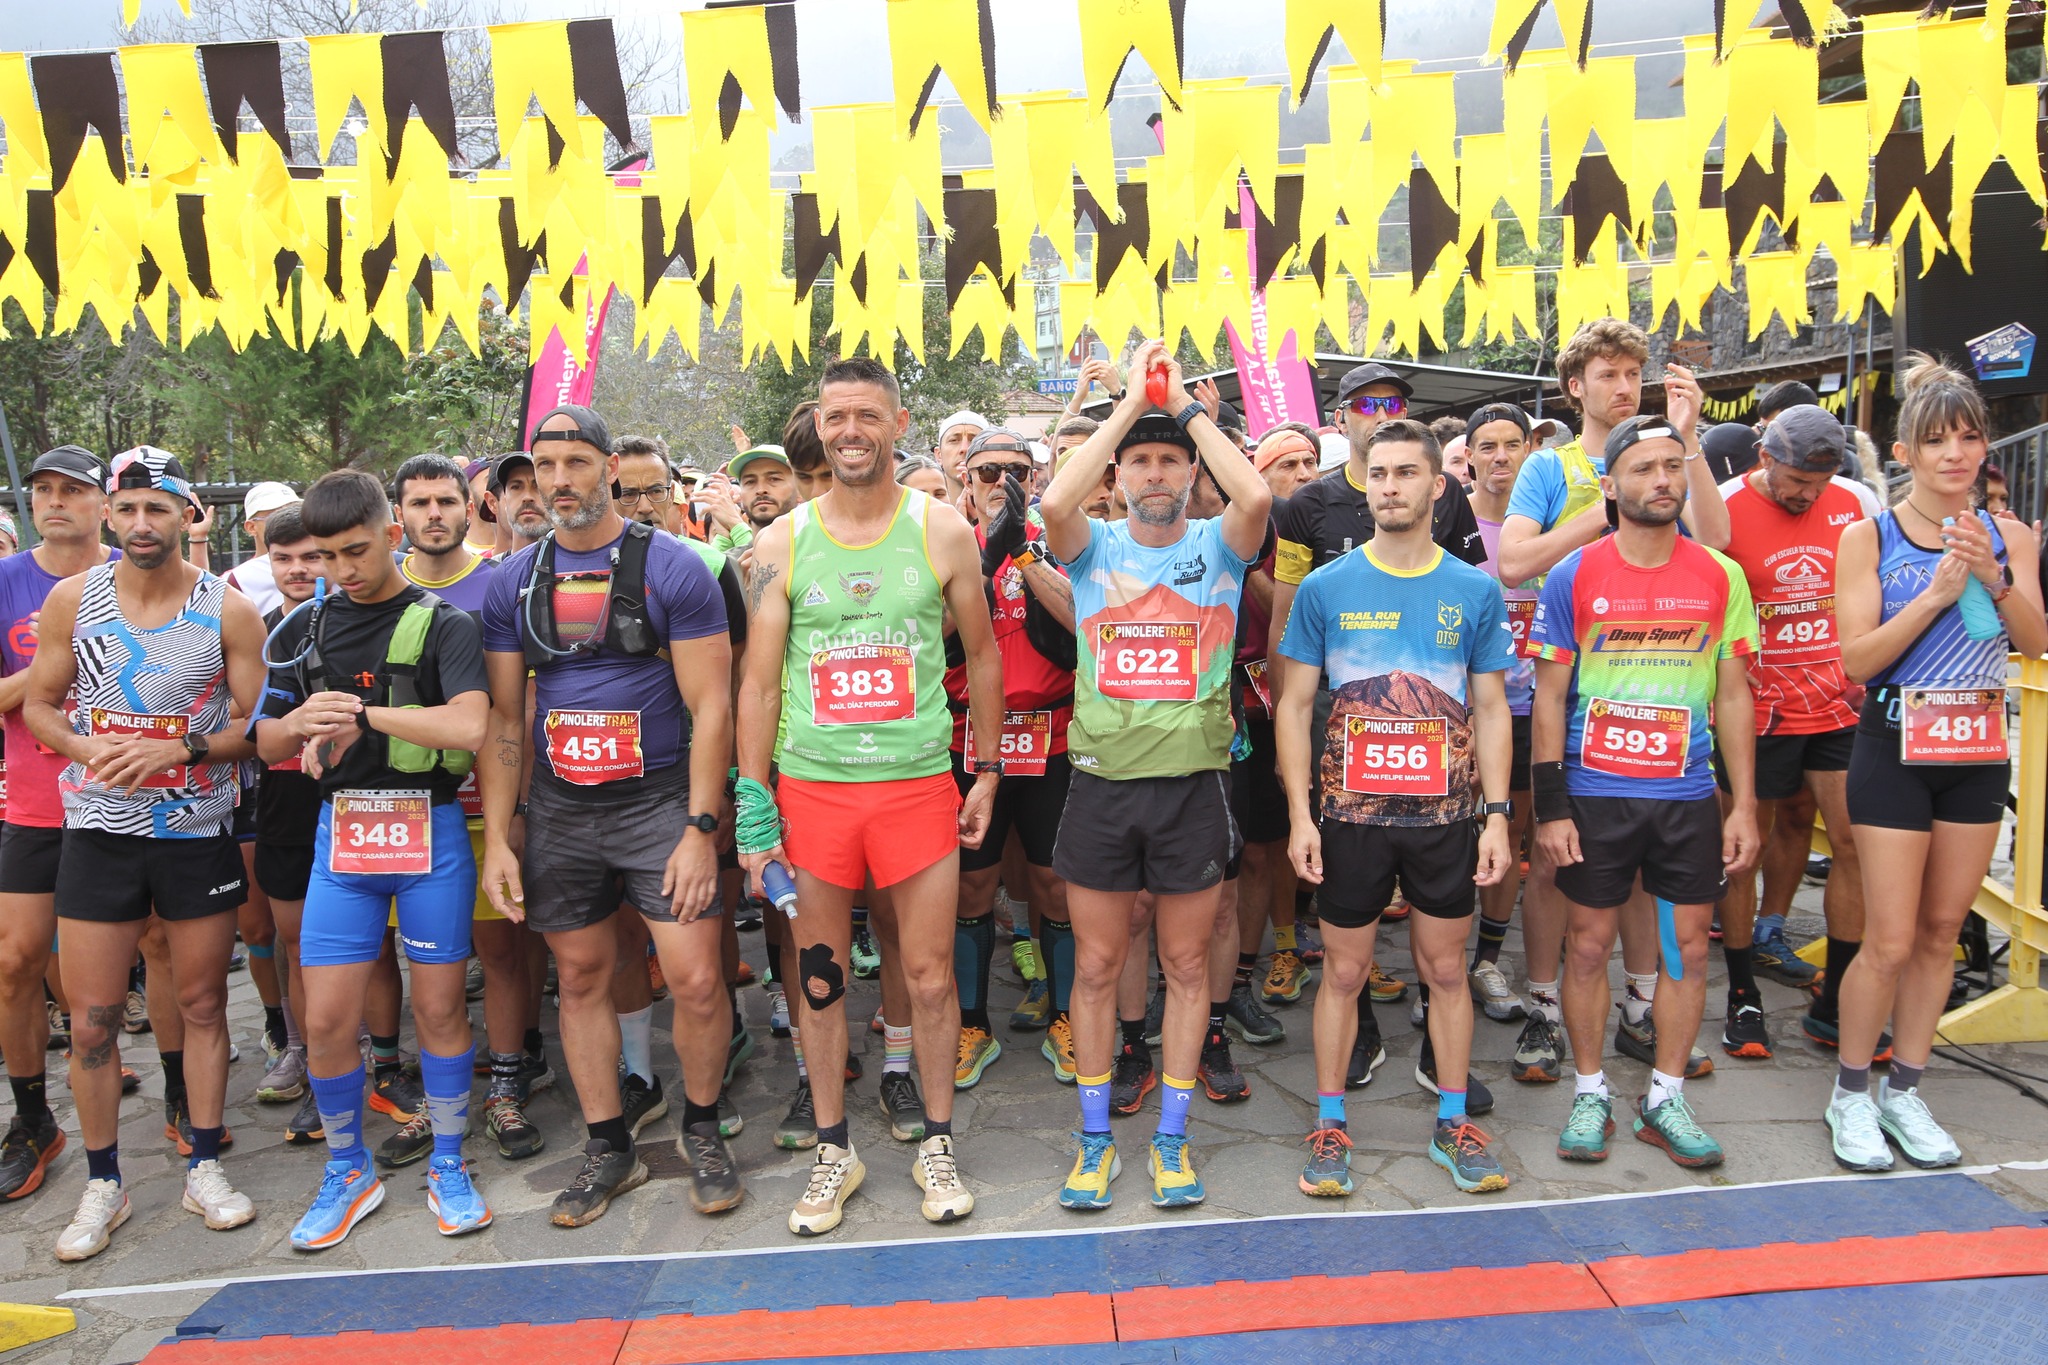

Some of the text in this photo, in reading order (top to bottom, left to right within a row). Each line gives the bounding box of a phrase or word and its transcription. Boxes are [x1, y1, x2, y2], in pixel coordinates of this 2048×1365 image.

[1764, 556, 1777, 567] CLUB
[1777, 548, 1799, 560] ESCUELA
[1787, 591, 1818, 599] TENERIFE
[1658, 600, 1674, 609] TD
[1339, 611, 1402, 621] TRAIL RUN
[1339, 620, 1400, 631] TENERIFE
[1776, 618, 1830, 644] 492
[808, 625, 908, 651] Curbelo
[1436, 630, 1460, 646] OTSO
[1607, 626, 1696, 646] Dany Sport
[1760, 647, 1794, 656] FERNANDO
[1794, 644, 1828, 654] HERNÁNDEZ
[892, 658, 911, 666] 2025
[1116, 648, 1179, 674] 622
[1608, 658, 1693, 667] FUERTEVENTURA
[830, 668, 895, 697] 383
[1130, 679, 1165, 687] POMBROL
[1612, 682, 1689, 699] ARMAS
[828, 699, 899, 711] RAÚL DÍAZ PERDOMO
[1668, 723, 1687, 732] 2025
[1927, 715, 1987, 742] 481
[1426, 734, 1444, 742] 2025
[1604, 726, 1668, 757] 593
[562, 736, 619, 761] 451
[1934, 746, 1977, 754] HERNÁNDEZ
[839, 755, 897, 764] TENERIFE
[1364, 743, 1428, 770] 556
[1590, 751, 1678, 768] TOMAS JONATHAN NEGRÍN
[569, 761, 603, 772] GONZÁLEZ
[603, 761, 640, 771] GONZÁLEZ
[1361, 773, 1380, 781] JUAN
[1404, 774, 1431, 782] MARTIN
[349, 822, 410, 847] 348
[361, 850, 395, 860] CASAÑAS
[395, 851, 424, 859] AFONSO
